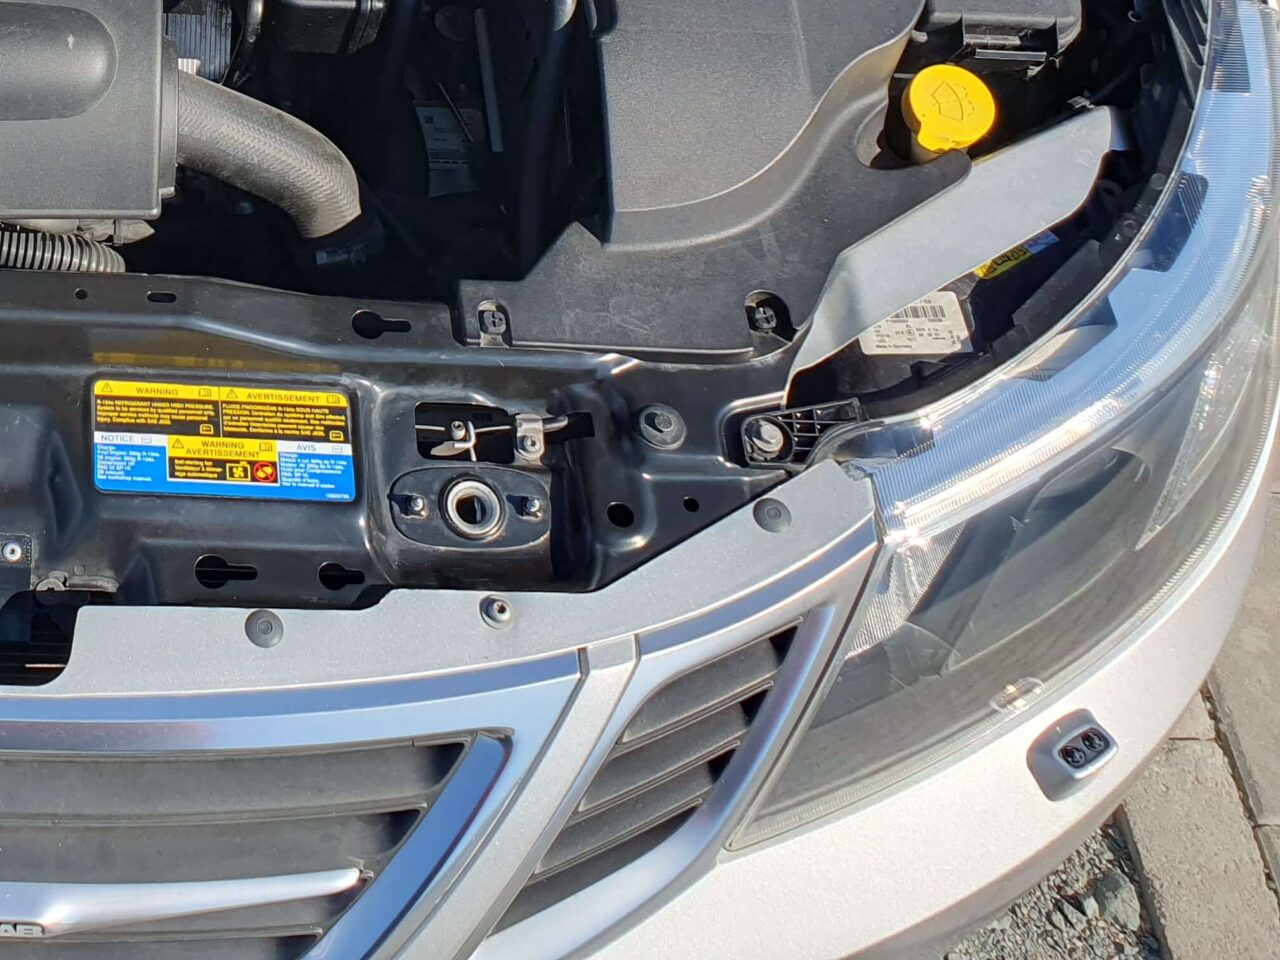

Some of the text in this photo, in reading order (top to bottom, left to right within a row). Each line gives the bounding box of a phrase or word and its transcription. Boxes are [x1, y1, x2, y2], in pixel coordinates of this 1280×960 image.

[136, 386, 178, 396] WARNING
[246, 392, 320, 402] AVERTISSEMENT
[100, 434, 135, 442] NOTICE
[201, 440, 244, 449] WARNING
[296, 444, 316, 452] AVIS
[186, 448, 260, 458] AVERTISSEMENT
